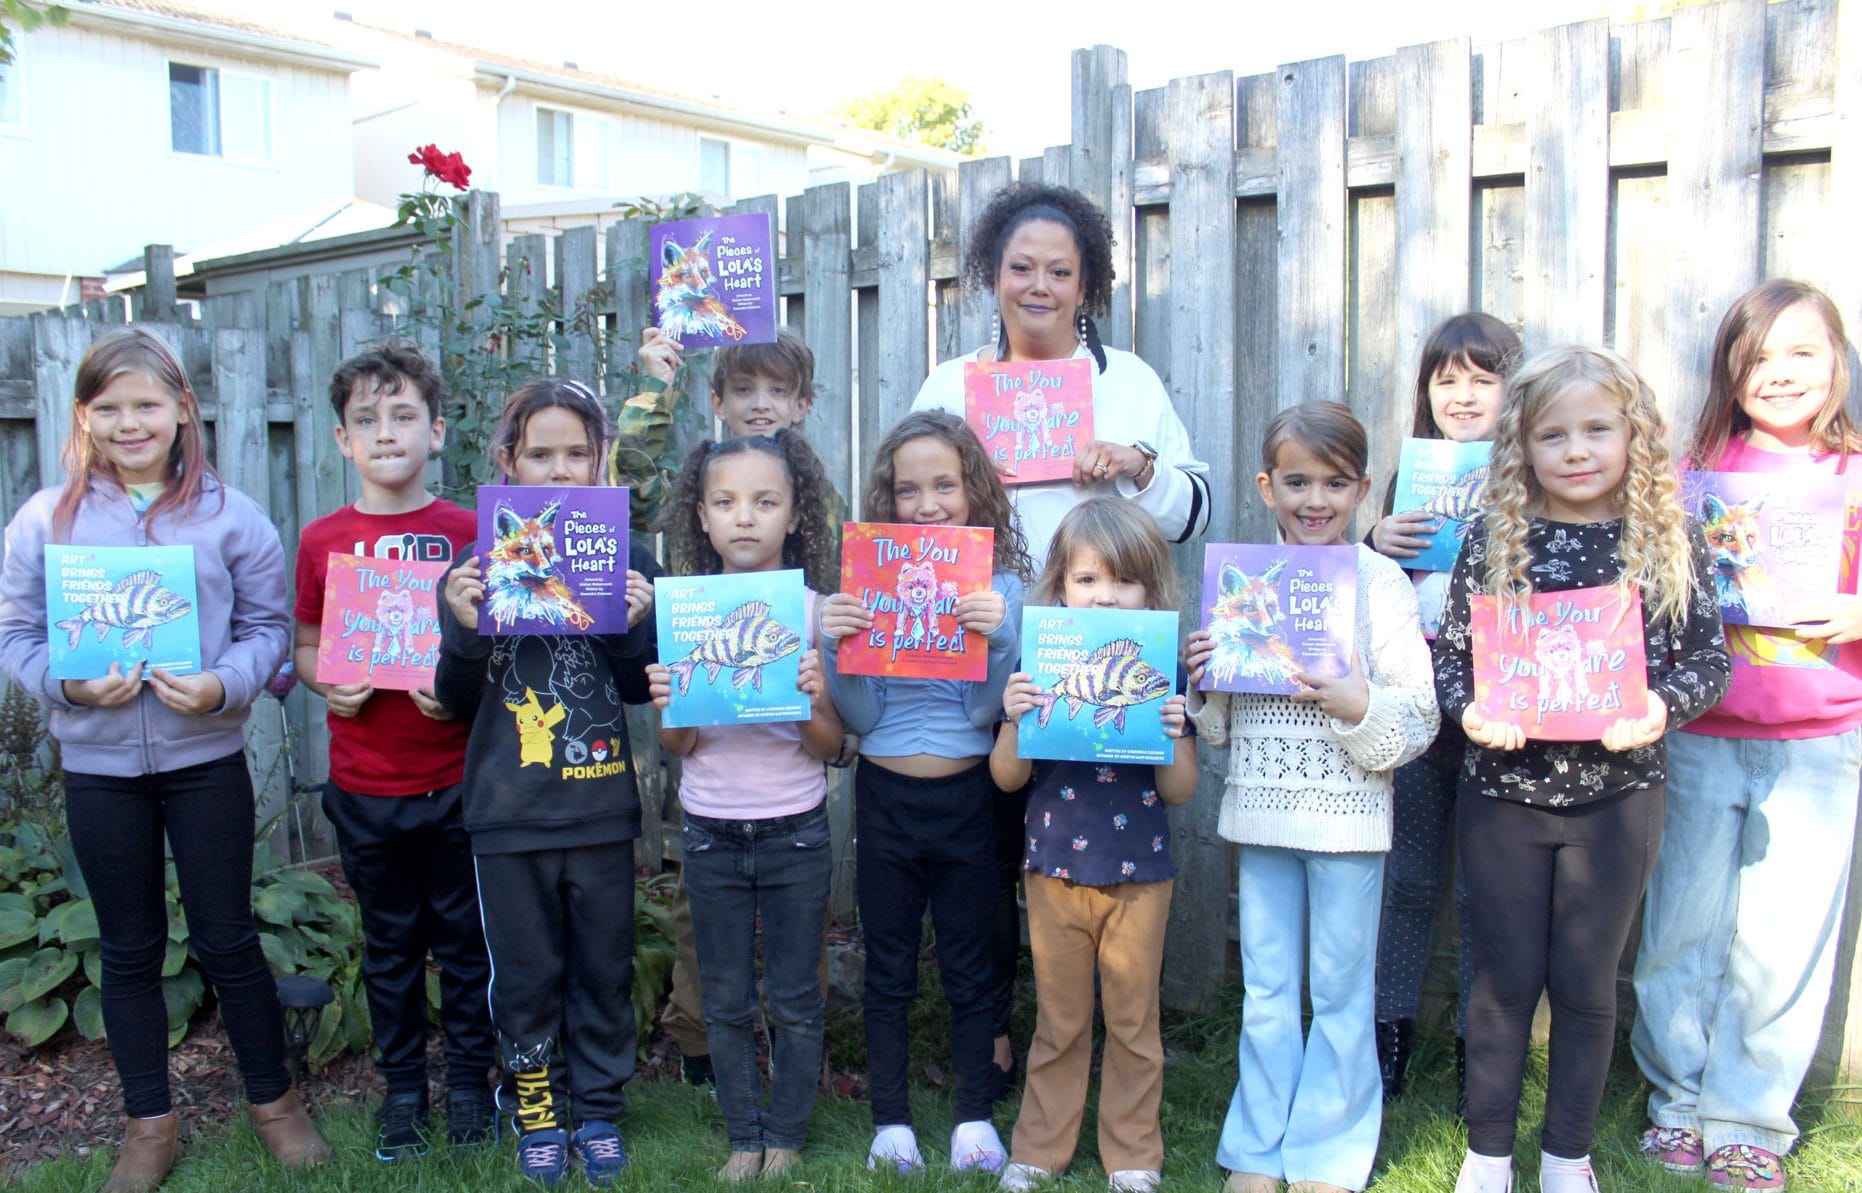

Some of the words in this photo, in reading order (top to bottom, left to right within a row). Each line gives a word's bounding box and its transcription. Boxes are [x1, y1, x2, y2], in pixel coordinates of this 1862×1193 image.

[717, 246, 752, 258] Pieces
[724, 274, 762, 291] Heart
[991, 373, 1023, 397] The
[1047, 409, 1080, 429] are
[994, 445, 1008, 460] is
[1014, 434, 1075, 471] perfect
[570, 510, 587, 519] The
[564, 521, 606, 535] Pieces
[565, 537, 618, 556] LOLA'S
[872, 537, 912, 567] The
[61, 555, 85, 565] ART
[571, 556, 616, 573] Heart
[61, 567, 106, 578] BRINGS
[1297, 568, 1313, 577] The
[62, 580, 112, 591] FRIENDS
[356, 568, 391, 592] The
[1289, 579, 1335, 593] Pieces
[63, 592, 125, 603] TOGETHER
[671, 588, 695, 599] ART
[671, 602, 716, 613] BRINGS
[672, 615, 723, 628] FRIENDS
[1039, 618, 1064, 630] ART
[673, 629, 734, 642] TOGETHER
[1038, 634, 1084, 646] BRINGS
[869, 628, 886, 647] is
[892, 624, 966, 662] perfect
[348, 645, 364, 661] is
[368, 643, 439, 676] perfect
[1037, 648, 1089, 661] FRIENDS
[1583, 649, 1627, 675] are
[1037, 662, 1101, 677] TOGETHER
[1510, 691, 1529, 710] is
[1537, 681, 1622, 725] perfect
[562, 760, 626, 780] POKÉMON
